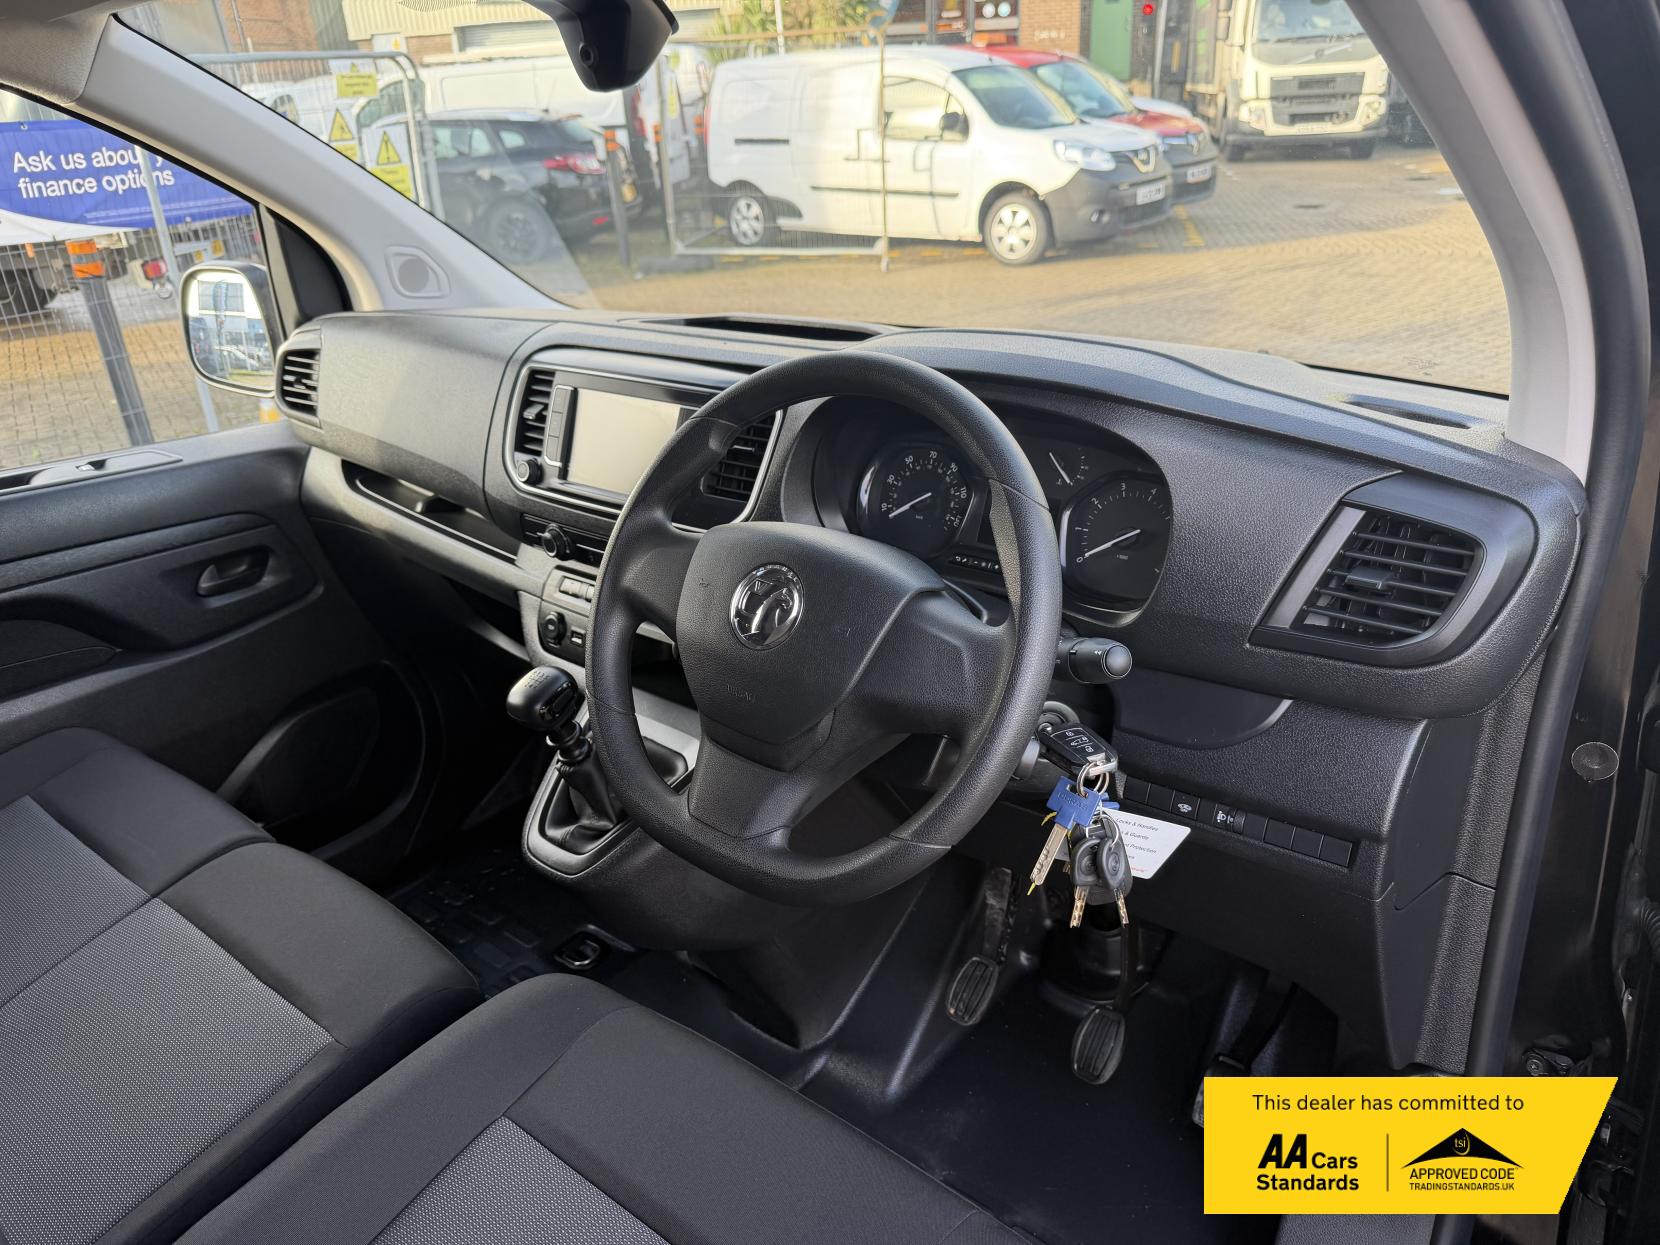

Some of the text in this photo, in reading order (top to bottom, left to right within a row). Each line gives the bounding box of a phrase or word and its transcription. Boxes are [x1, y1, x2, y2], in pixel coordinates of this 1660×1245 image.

[13, 150, 56, 173] Ask
[60, 153, 87, 170] us
[92, 147, 145, 168] abou
[18, 177, 97, 198] finance
[929, 451, 938, 459] 70
[904, 455, 914, 465] 50
[1120, 482, 1126, 491] 3
[1091, 497, 1098, 505] 2
[881, 502, 887, 512] 10
[1137, 823, 1159, 832] Handles
